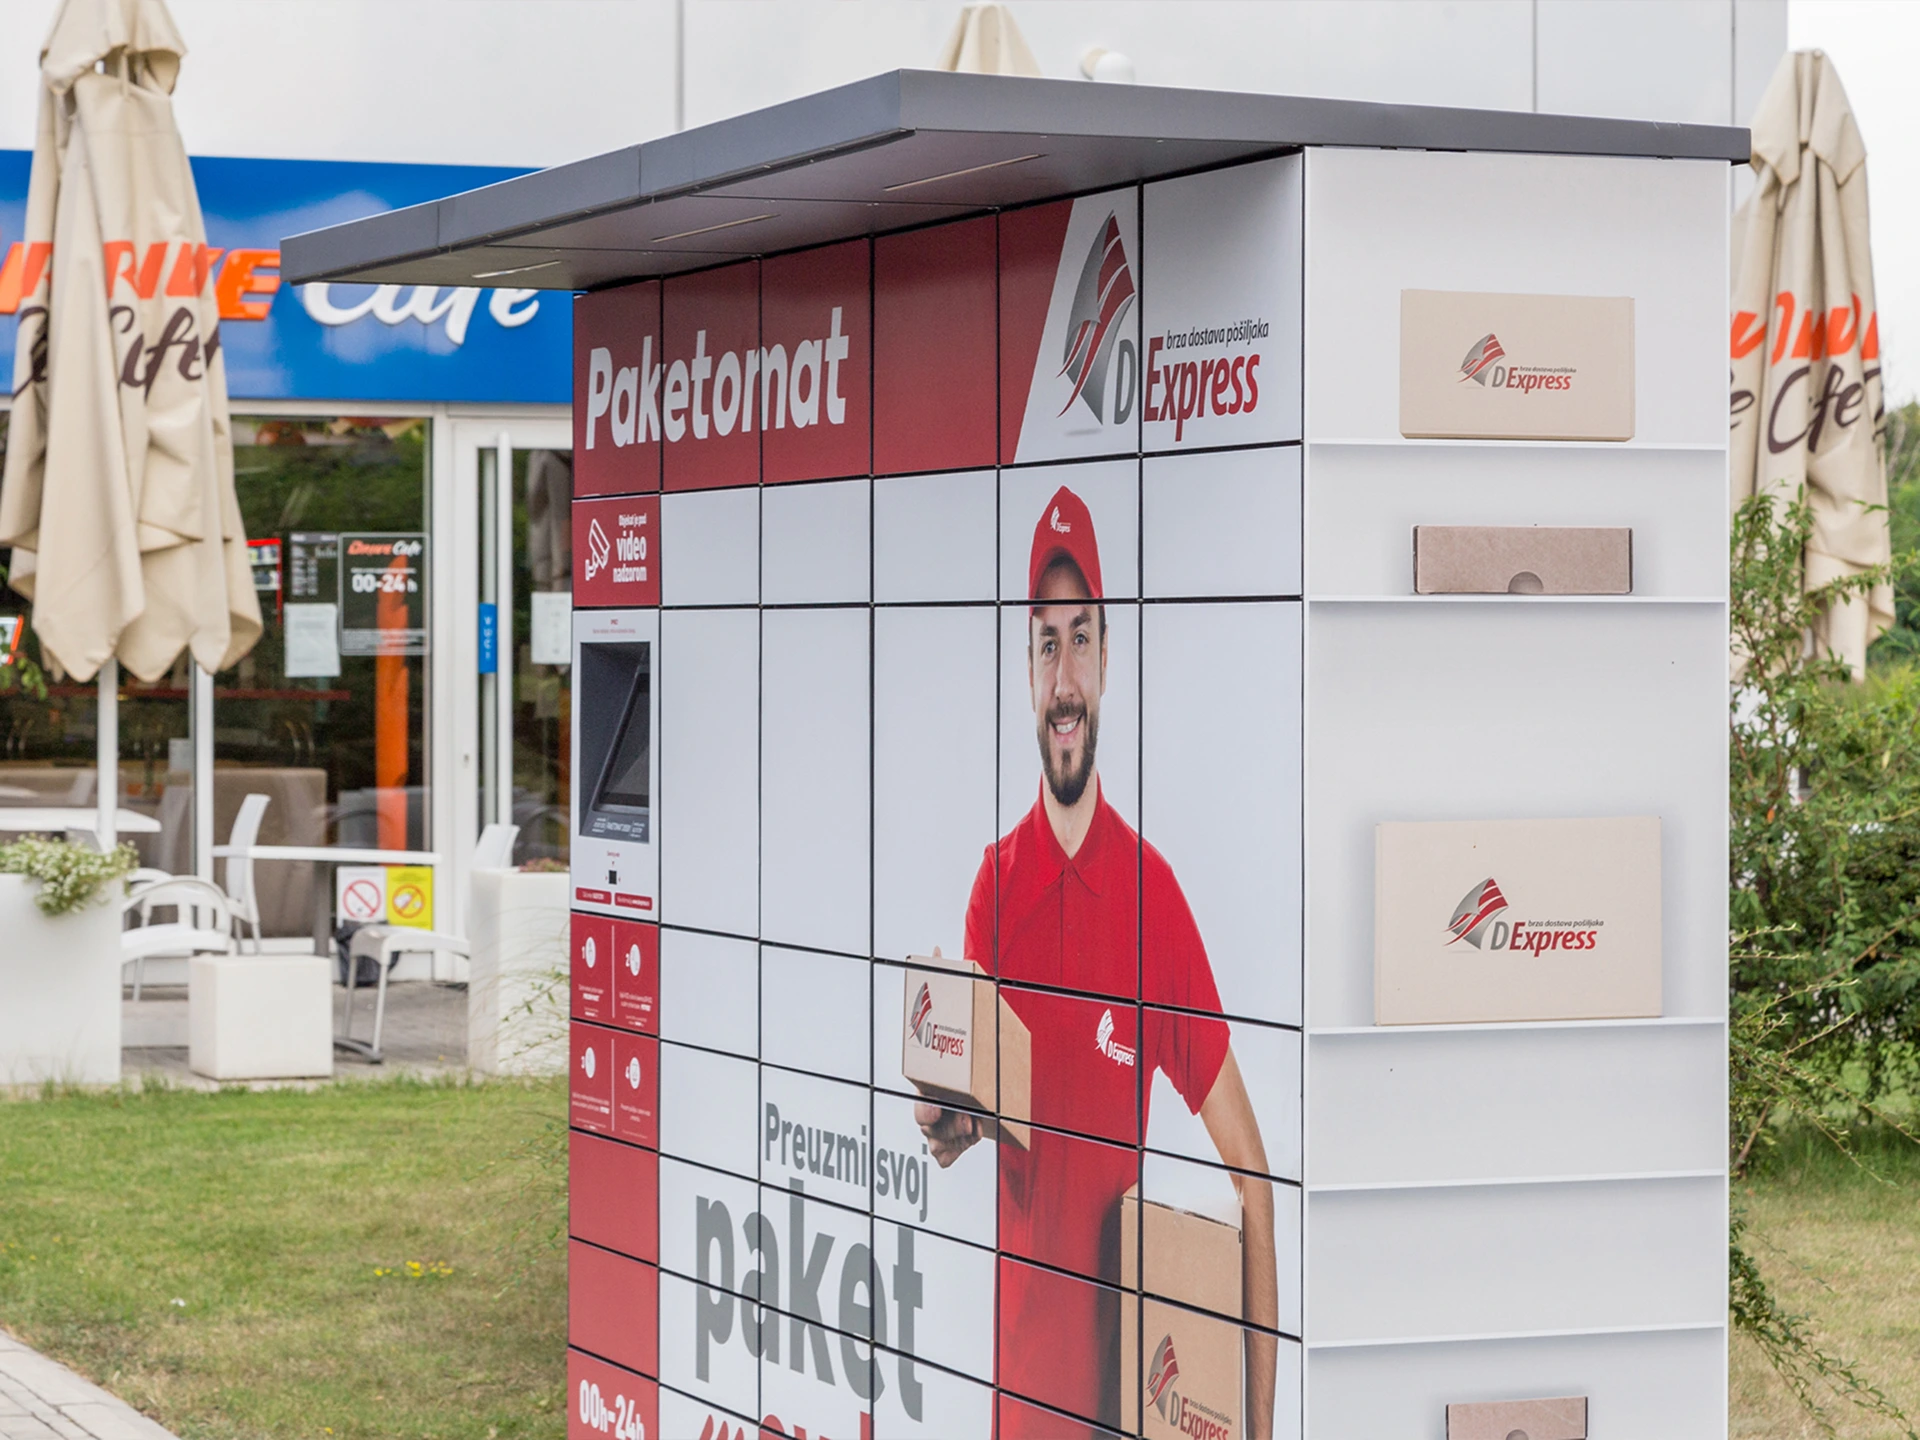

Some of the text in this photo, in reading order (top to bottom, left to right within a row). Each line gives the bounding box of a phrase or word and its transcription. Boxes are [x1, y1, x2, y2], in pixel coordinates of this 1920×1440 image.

[1166, 330, 1187, 350] brza
[1189, 327, 1225, 347] dostava
[586, 306, 849, 450] Paketomat
[616, 530, 647, 561] video
[352, 573, 406, 593] 00-24
[613, 564, 647, 583] nadzorom
[765, 1102, 928, 1222] Preuzmi svoj
[696, 1177, 923, 1423] paket
[579, 1378, 645, 1440] 00h-24h
